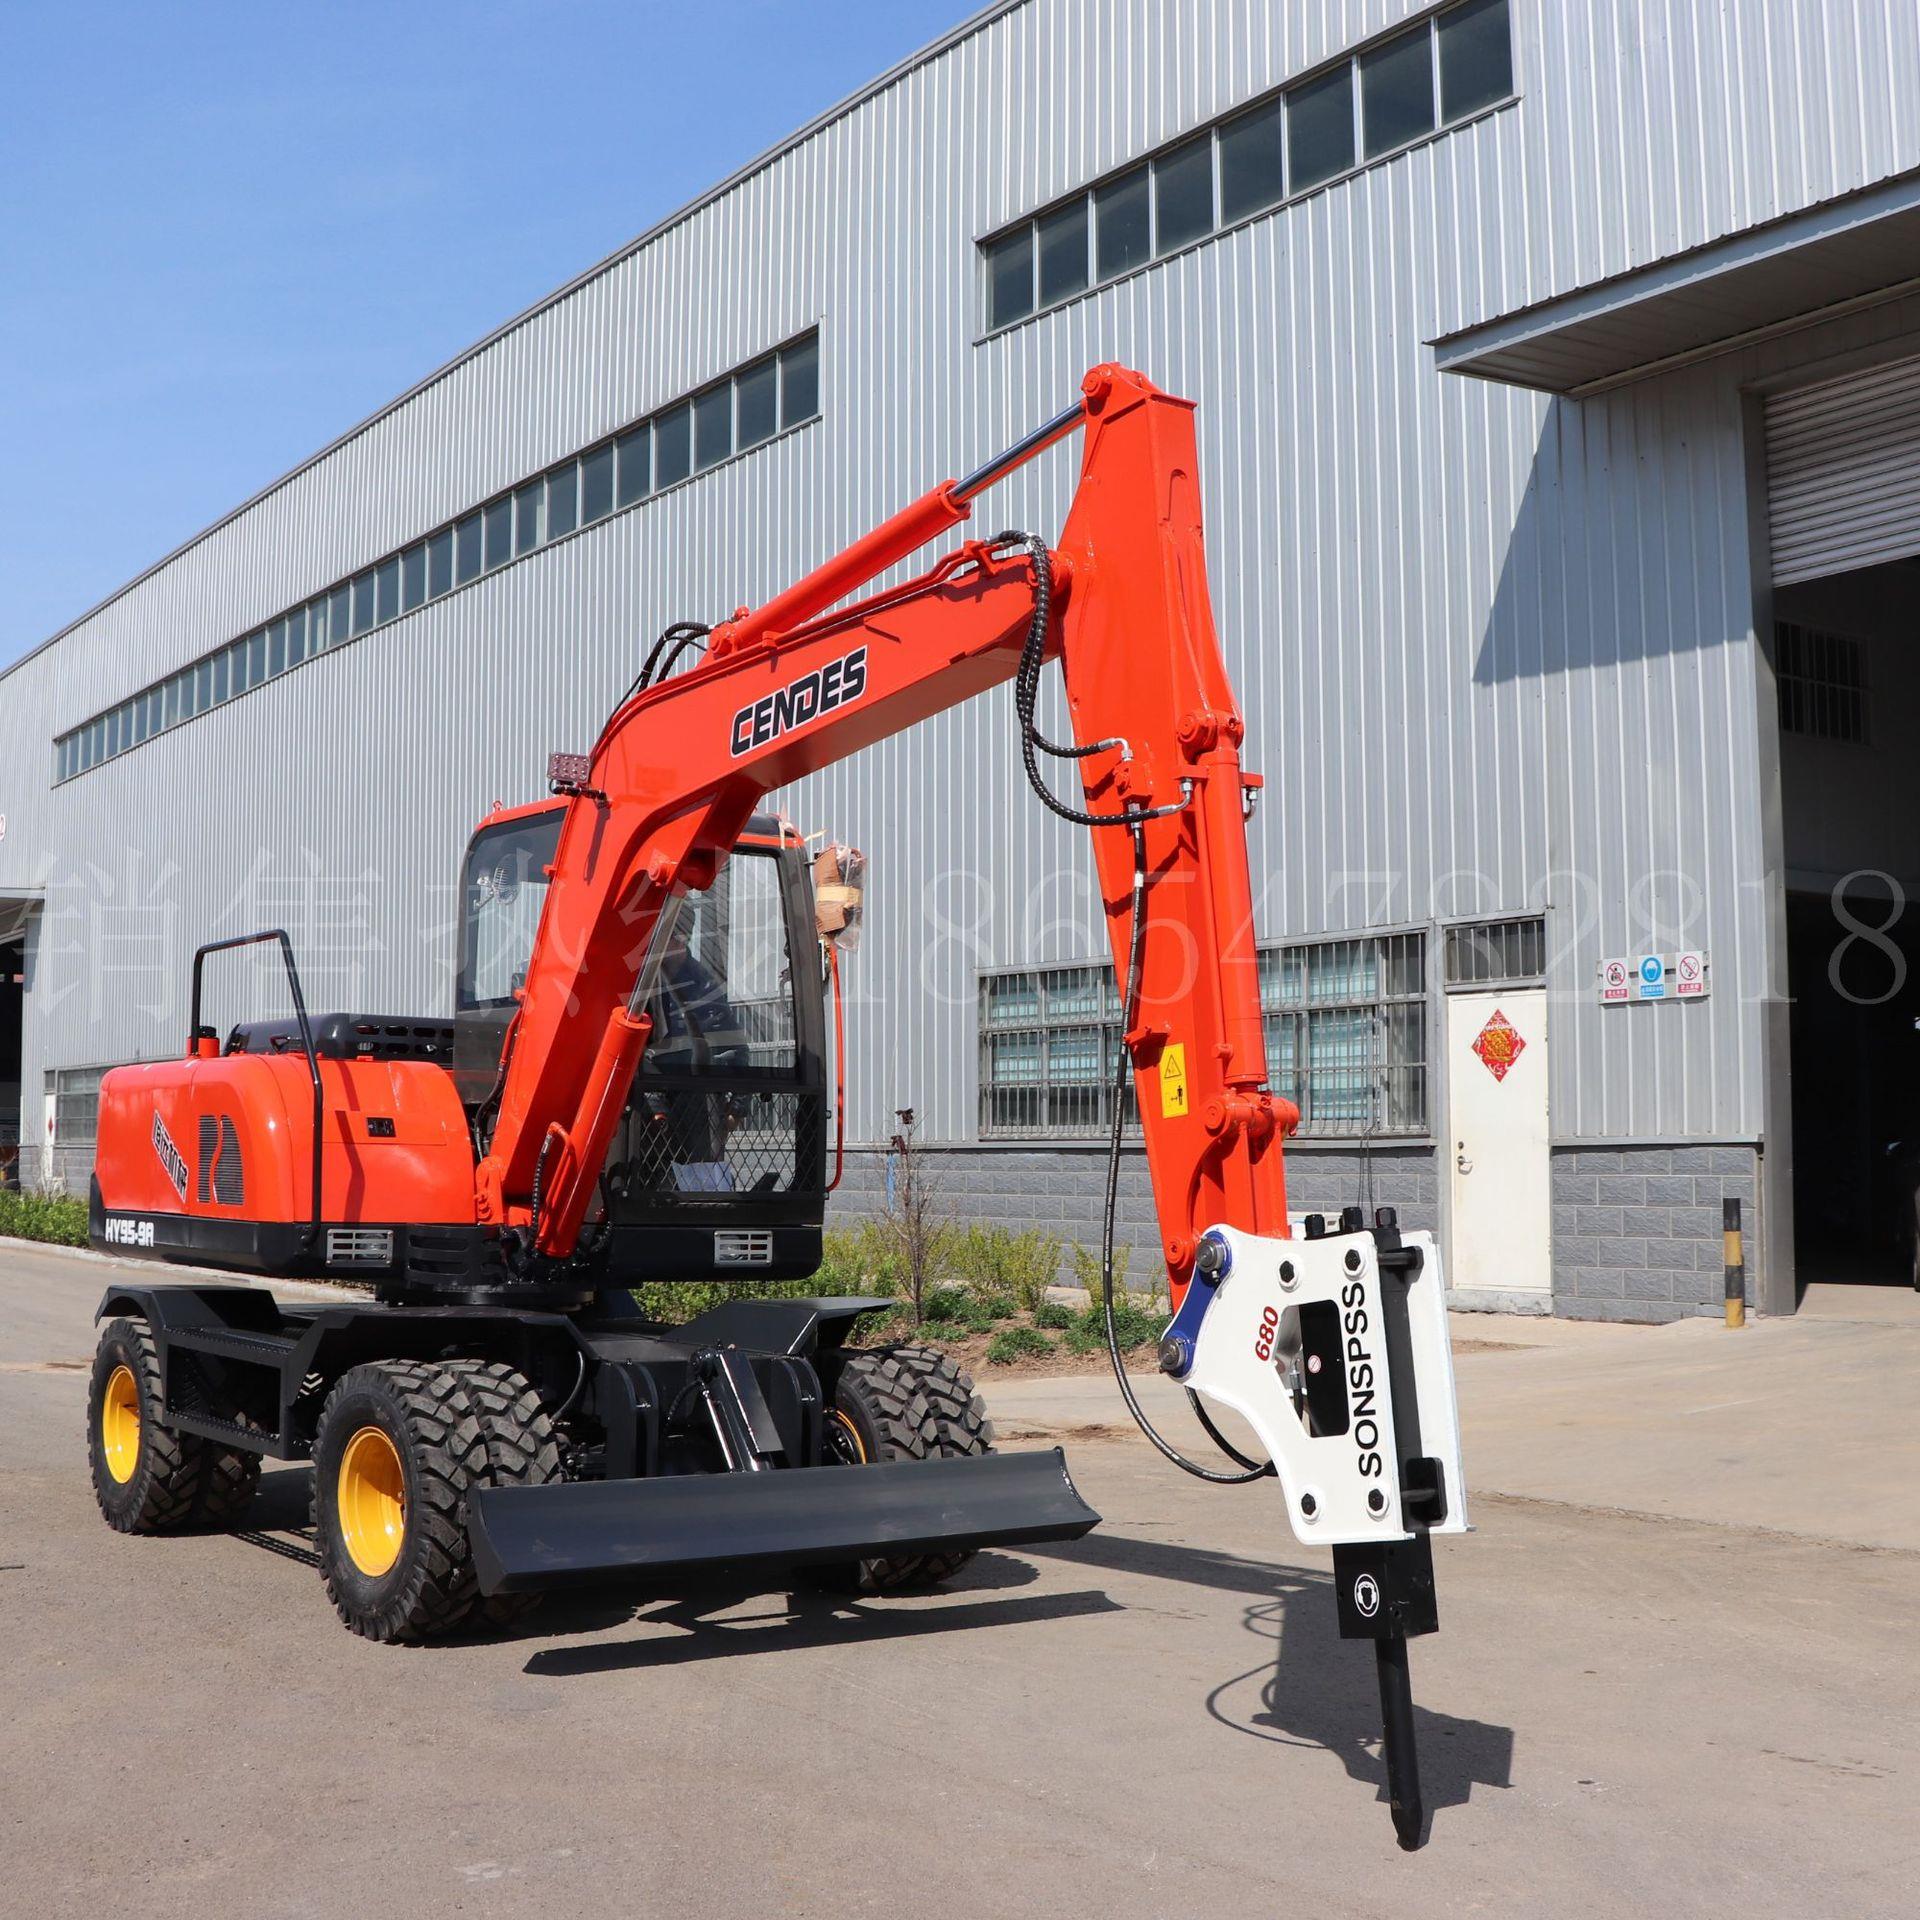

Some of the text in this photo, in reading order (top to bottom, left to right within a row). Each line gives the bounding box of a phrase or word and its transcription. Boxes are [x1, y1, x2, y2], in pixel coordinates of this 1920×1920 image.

[731, 644, 868, 758] CENDES
[105, 1218, 155, 1247] HY95-9A
[1255, 1305, 1280, 1363] 680
[1342, 1281, 1383, 1478] SONSPSS
